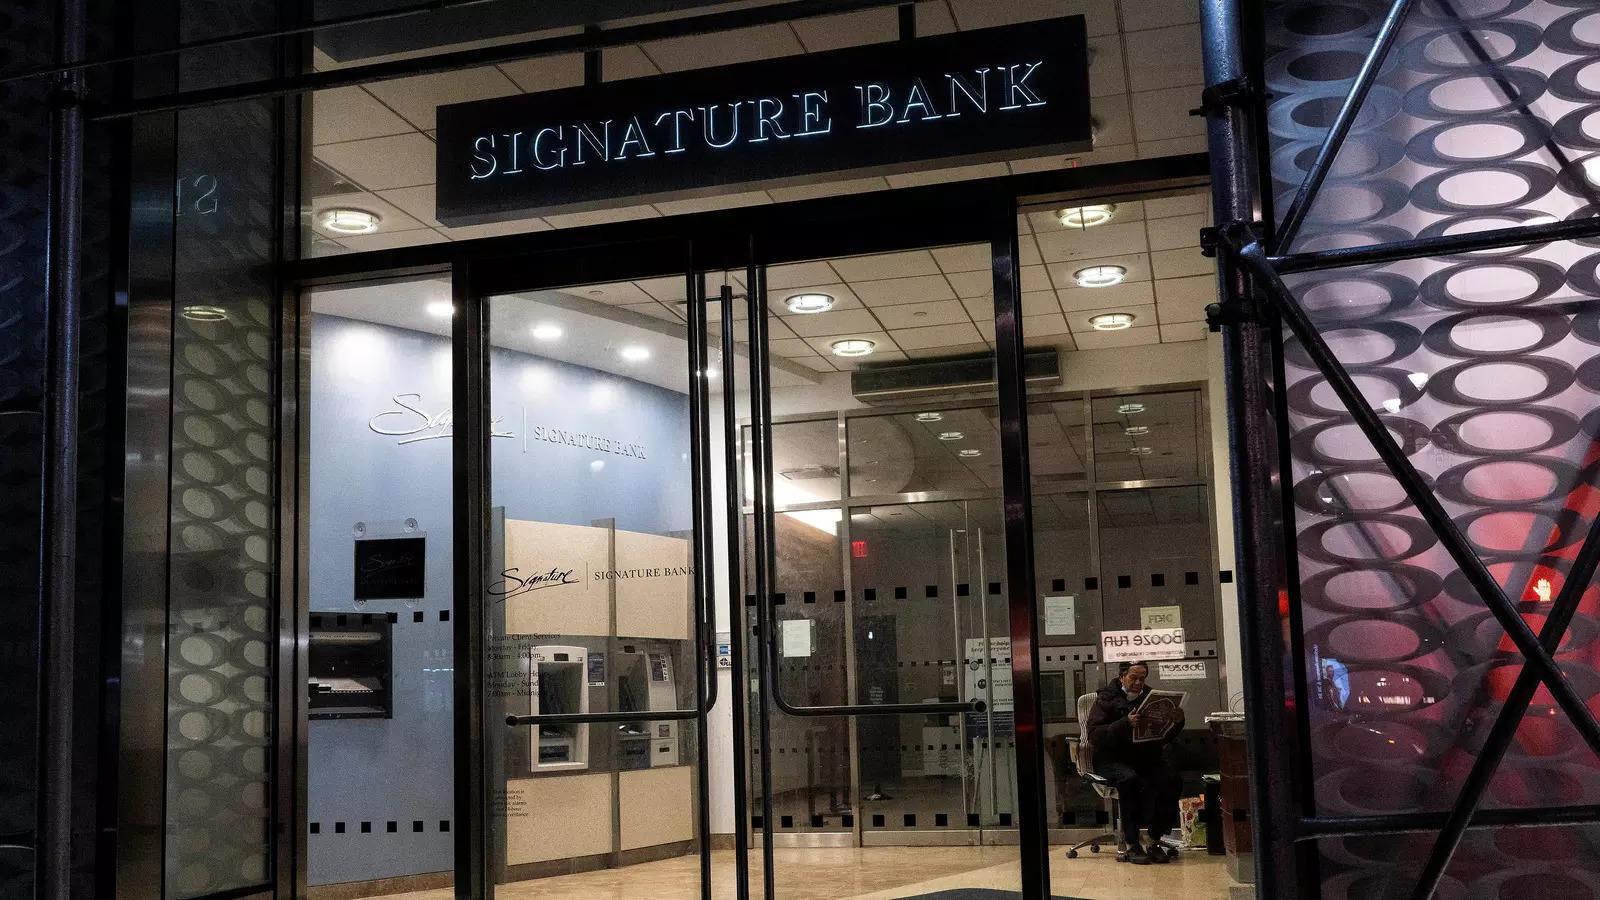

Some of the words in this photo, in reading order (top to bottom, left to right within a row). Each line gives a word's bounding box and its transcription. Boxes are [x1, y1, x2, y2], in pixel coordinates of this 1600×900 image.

[470, 90, 832, 180] SIGNATURE
[854, 60, 1047, 129] BANK
[534, 426, 611, 453] SIGNATURE
[614, 440, 648, 460] BANK
[487, 567, 580, 603] Signature
[594, 569, 661, 581] SIGNATURE
[664, 566, 696, 577] BANK
